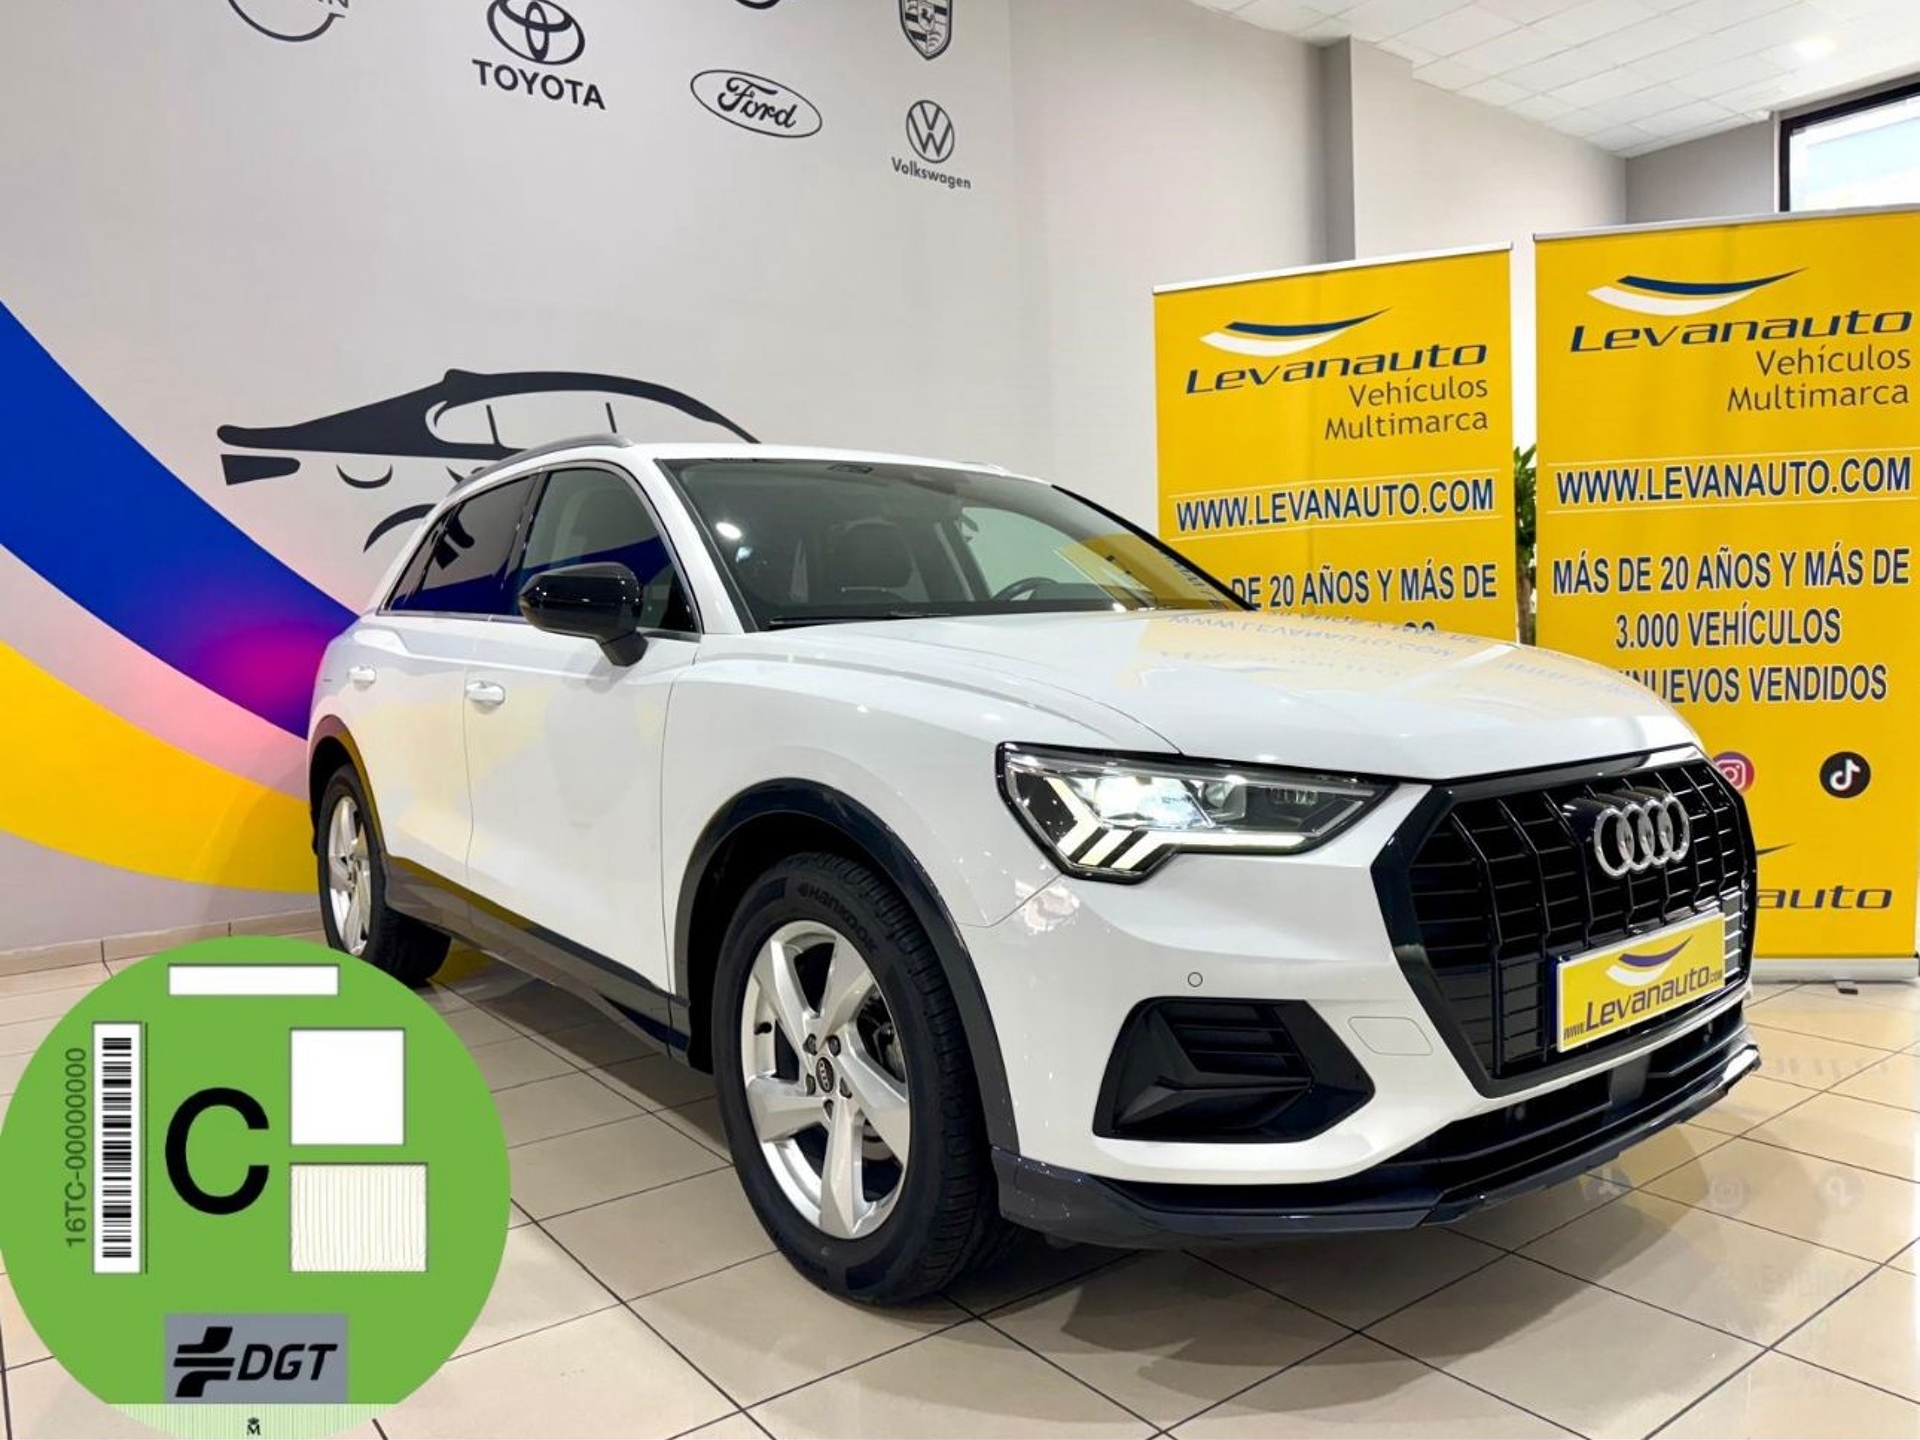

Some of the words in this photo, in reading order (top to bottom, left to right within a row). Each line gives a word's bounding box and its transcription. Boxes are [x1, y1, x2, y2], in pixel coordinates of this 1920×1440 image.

[472, 58, 605, 110] TOYOTA
[717, 77, 798, 128] Ford
[892, 157, 972, 189] Volkswagen
[1570, 309, 1912, 352] Levanauto
[1186, 343, 1487, 394] Levanauto
[1756, 344, 1911, 376] Vehículos
[1348, 375, 1488, 407] Vehículos
[1727, 384, 1909, 412] Multimarca
[1324, 408, 1488, 440] Multimarca
[1557, 456, 1911, 504] WWW.LEVANAUTO.COM
[1176, 478, 1494, 532] WWW.LEVANAUTO.COM
[1269, 575, 1294, 607] 20
[1302, 565, 1369, 605] AÑOS
[1377, 569, 1392, 602] Y
[1401, 559, 1454, 601] MÁS
[1464, 564, 1497, 598] DE
[1553, 550, 1609, 594] MÁS
[1618, 557, 1651, 592] DE
[1661, 556, 1688, 590] 20
[1696, 546, 1771, 589] AÑOS
[1780, 552, 1797, 587] Y
[1804, 542, 1864, 586] MÁS
[1873, 548, 1910, 584] DE
[1616, 613, 1679, 649] 3.000
[1688, 602, 1841, 647] VEHÍCULOS
[1749, 664, 1887, 701] VENDIDOS
[1757, 885, 1893, 909] auto
